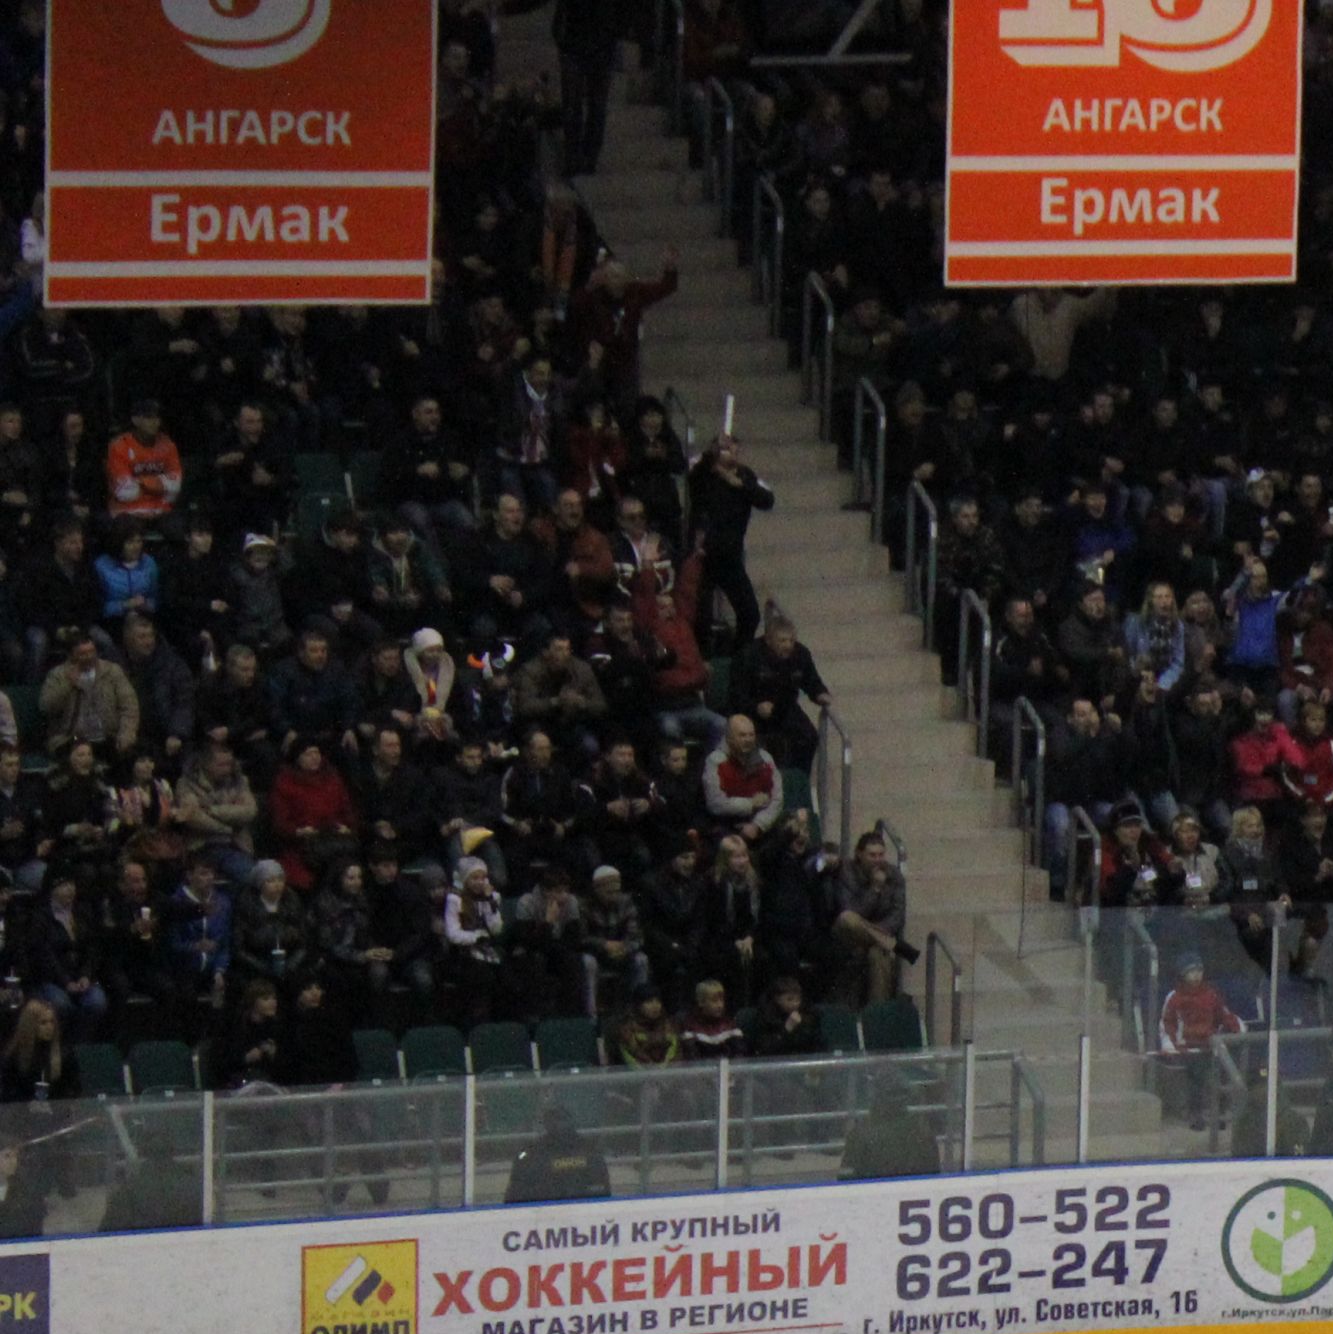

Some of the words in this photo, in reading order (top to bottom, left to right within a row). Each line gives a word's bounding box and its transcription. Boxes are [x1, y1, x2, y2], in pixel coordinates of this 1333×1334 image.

[152, 109, 351, 147] АНГАРСК
[1042, 97, 1224, 133] АНГАРСК
[149, 194, 350, 255] Ермак
[1040, 176, 1220, 236] Ермак
[502, 1218, 620, 1253] САМЫЙ
[631, 1209, 781, 1243] КРУПНЫЙ
[898, 1184, 1171, 1246] 560-522
[431, 1233, 847, 1317] ХОККЕЙНЫЙ
[898, 1238, 1169, 1301] 622-247
[640, 1310, 658, 1330] В
[670, 1298, 808, 1329] РЕГИОНЕ
[994, 1303, 1027, 1329] ул.
[1035, 1297, 1161, 1326] Советская,
[1169, 1290, 1198, 1316] 16
